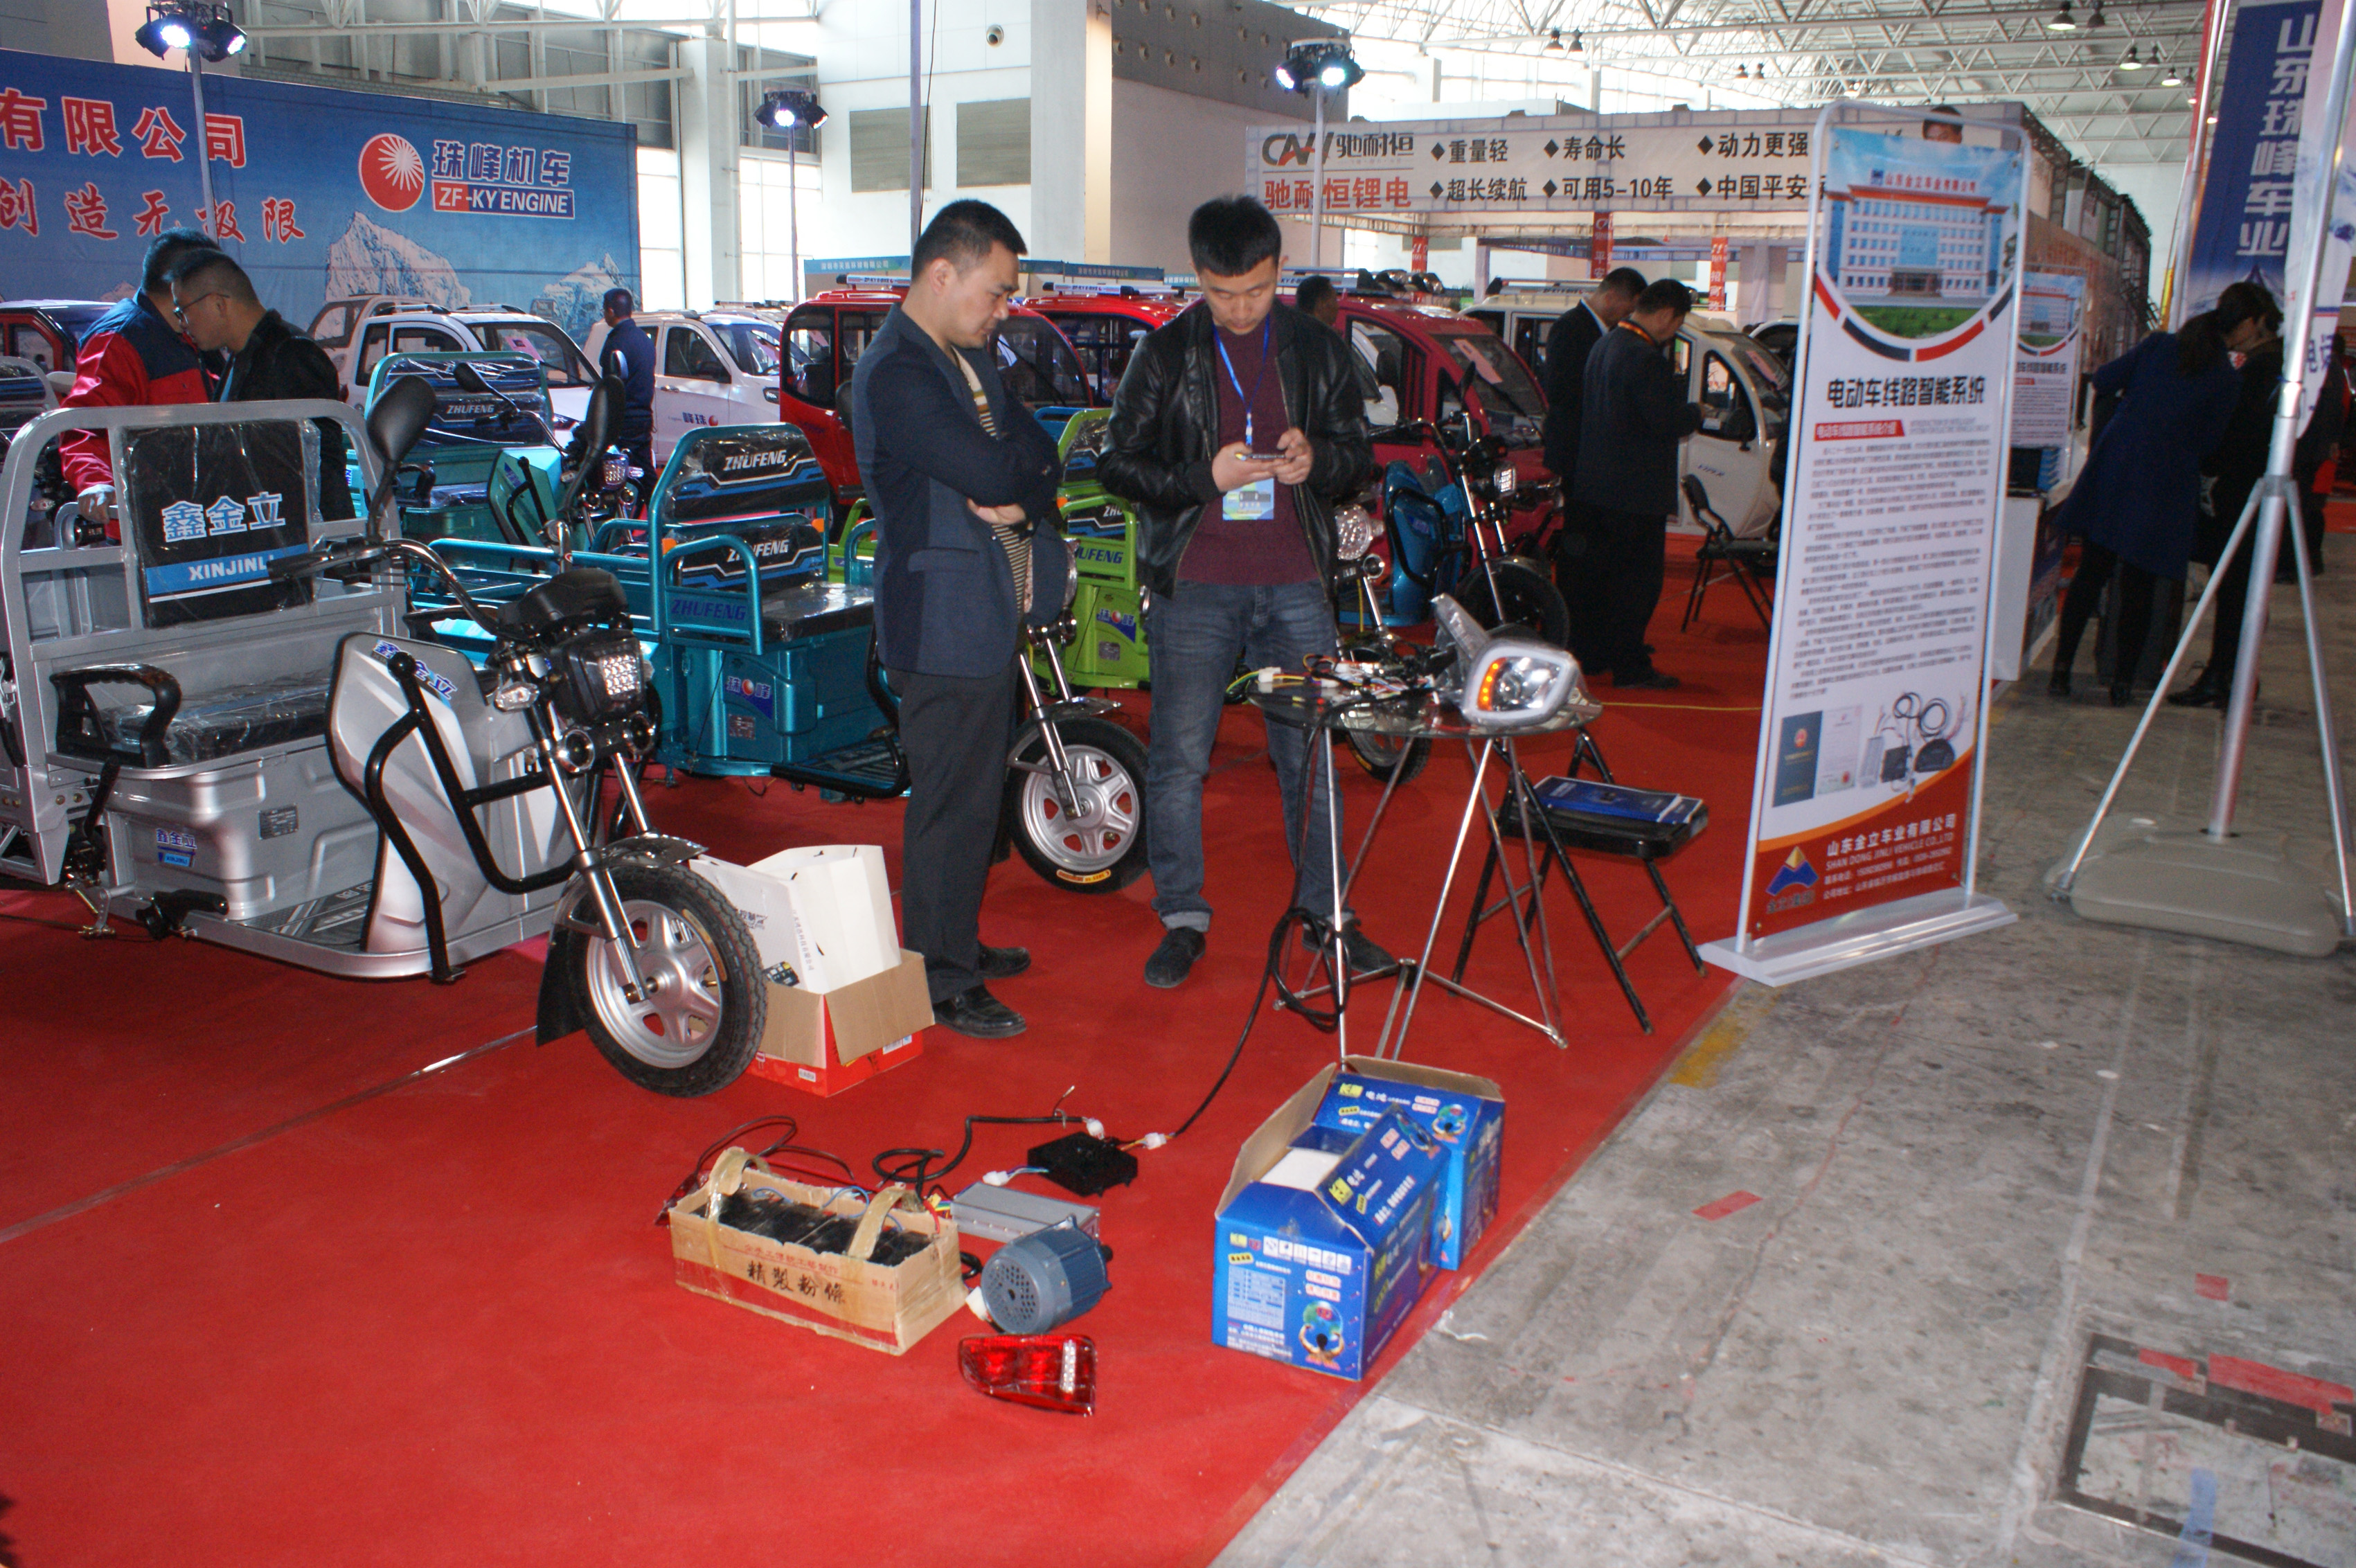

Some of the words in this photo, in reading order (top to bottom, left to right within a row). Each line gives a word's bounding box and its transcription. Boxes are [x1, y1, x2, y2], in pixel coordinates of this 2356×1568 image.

[0, 87, 247, 169] 有限公司
[2235, 14, 2314, 256] 山东珠峰车业
[1336, 132, 1414, 160] 驰耐恒
[1449, 139, 1508, 163] 重量轻
[1563, 136, 1625, 161] 寿命长
[1717, 132, 1808, 159] 动力更强
[431, 139, 571, 186] 珠峰机车
[1265, 176, 1411, 210] 驰耐恒锂电
[1447, 177, 1528, 202] 超长续航
[1562, 176, 1673, 201] 可用5-10年
[500, 190, 569, 214] ENGINE
[1827, 377, 1985, 408] 电动车线路智能系统
[447, 404, 495, 414] ZHUFENG
[723, 449, 787, 471] ZHUFENG
[161, 492, 286, 542] 鑫金立
[188, 555, 274, 580] XINJINL
[671, 599, 747, 621] ZHUFENG
[1827, 813, 1957, 857] 山东金立车业有限公司
